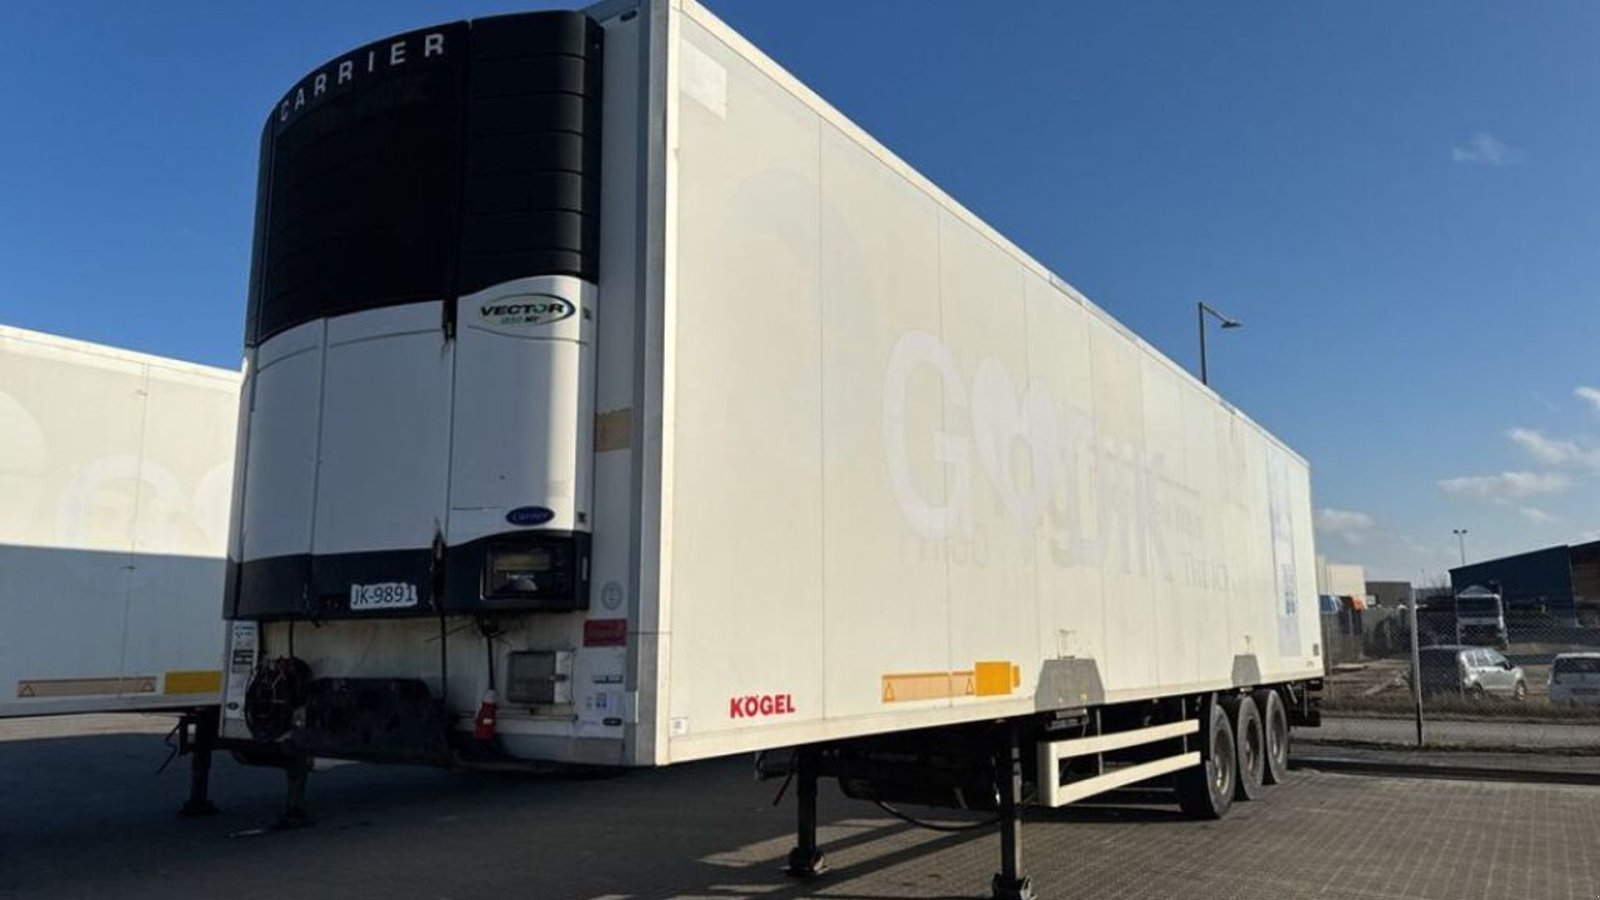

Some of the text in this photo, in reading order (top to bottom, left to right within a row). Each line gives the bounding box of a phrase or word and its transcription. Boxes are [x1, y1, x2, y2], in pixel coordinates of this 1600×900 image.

[281, 33, 445, 121] CARRIER
[481, 303, 564, 316] VECTOR
[353, 583, 415, 605] JK-9891
[730, 694, 796, 718] KÖGEL
